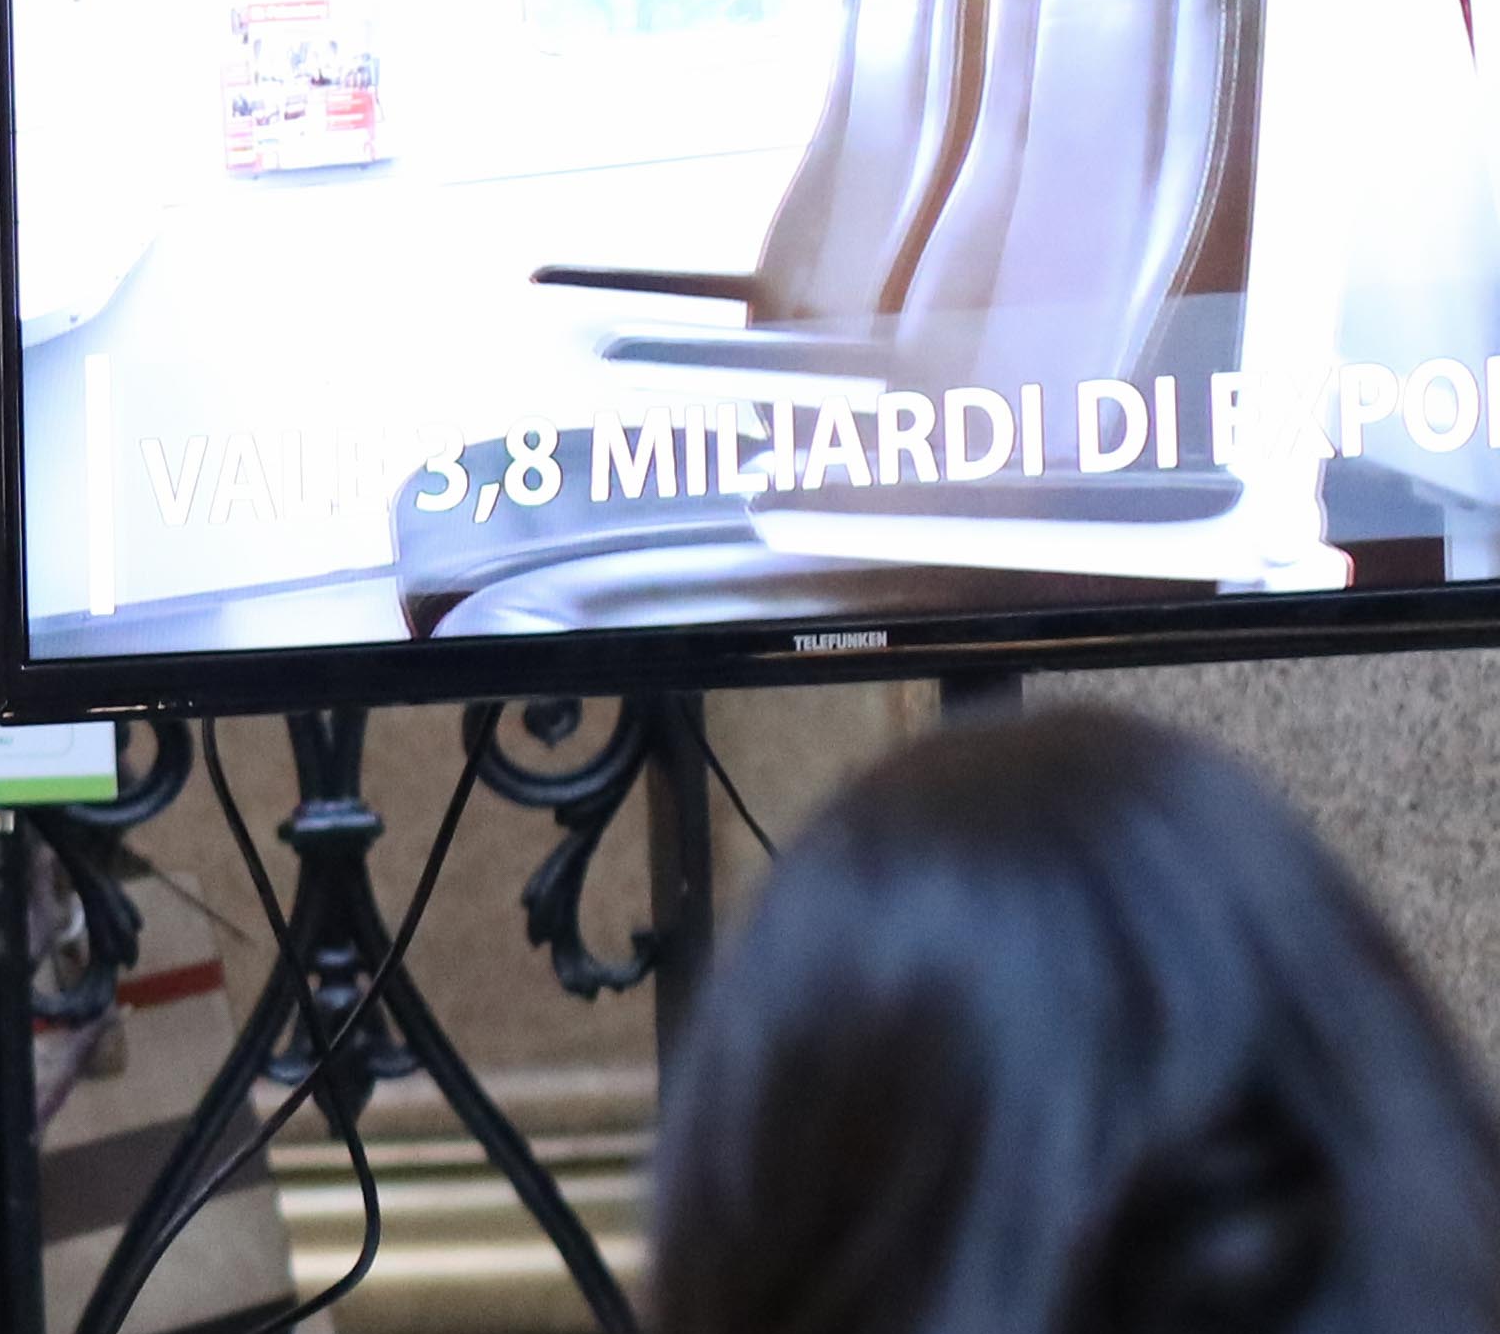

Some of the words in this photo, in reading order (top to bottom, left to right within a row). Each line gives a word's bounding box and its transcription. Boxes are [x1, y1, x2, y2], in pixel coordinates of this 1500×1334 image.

[139, 429, 388, 527] VALE
[414, 415, 563, 525] 3,8
[590, 383, 1044, 503] MILIARDI
[1076, 374, 1179, 474] DI
[1211, 355, 1500, 465] EXPO
[794, 630, 888, 651] TELEFUNKEN
